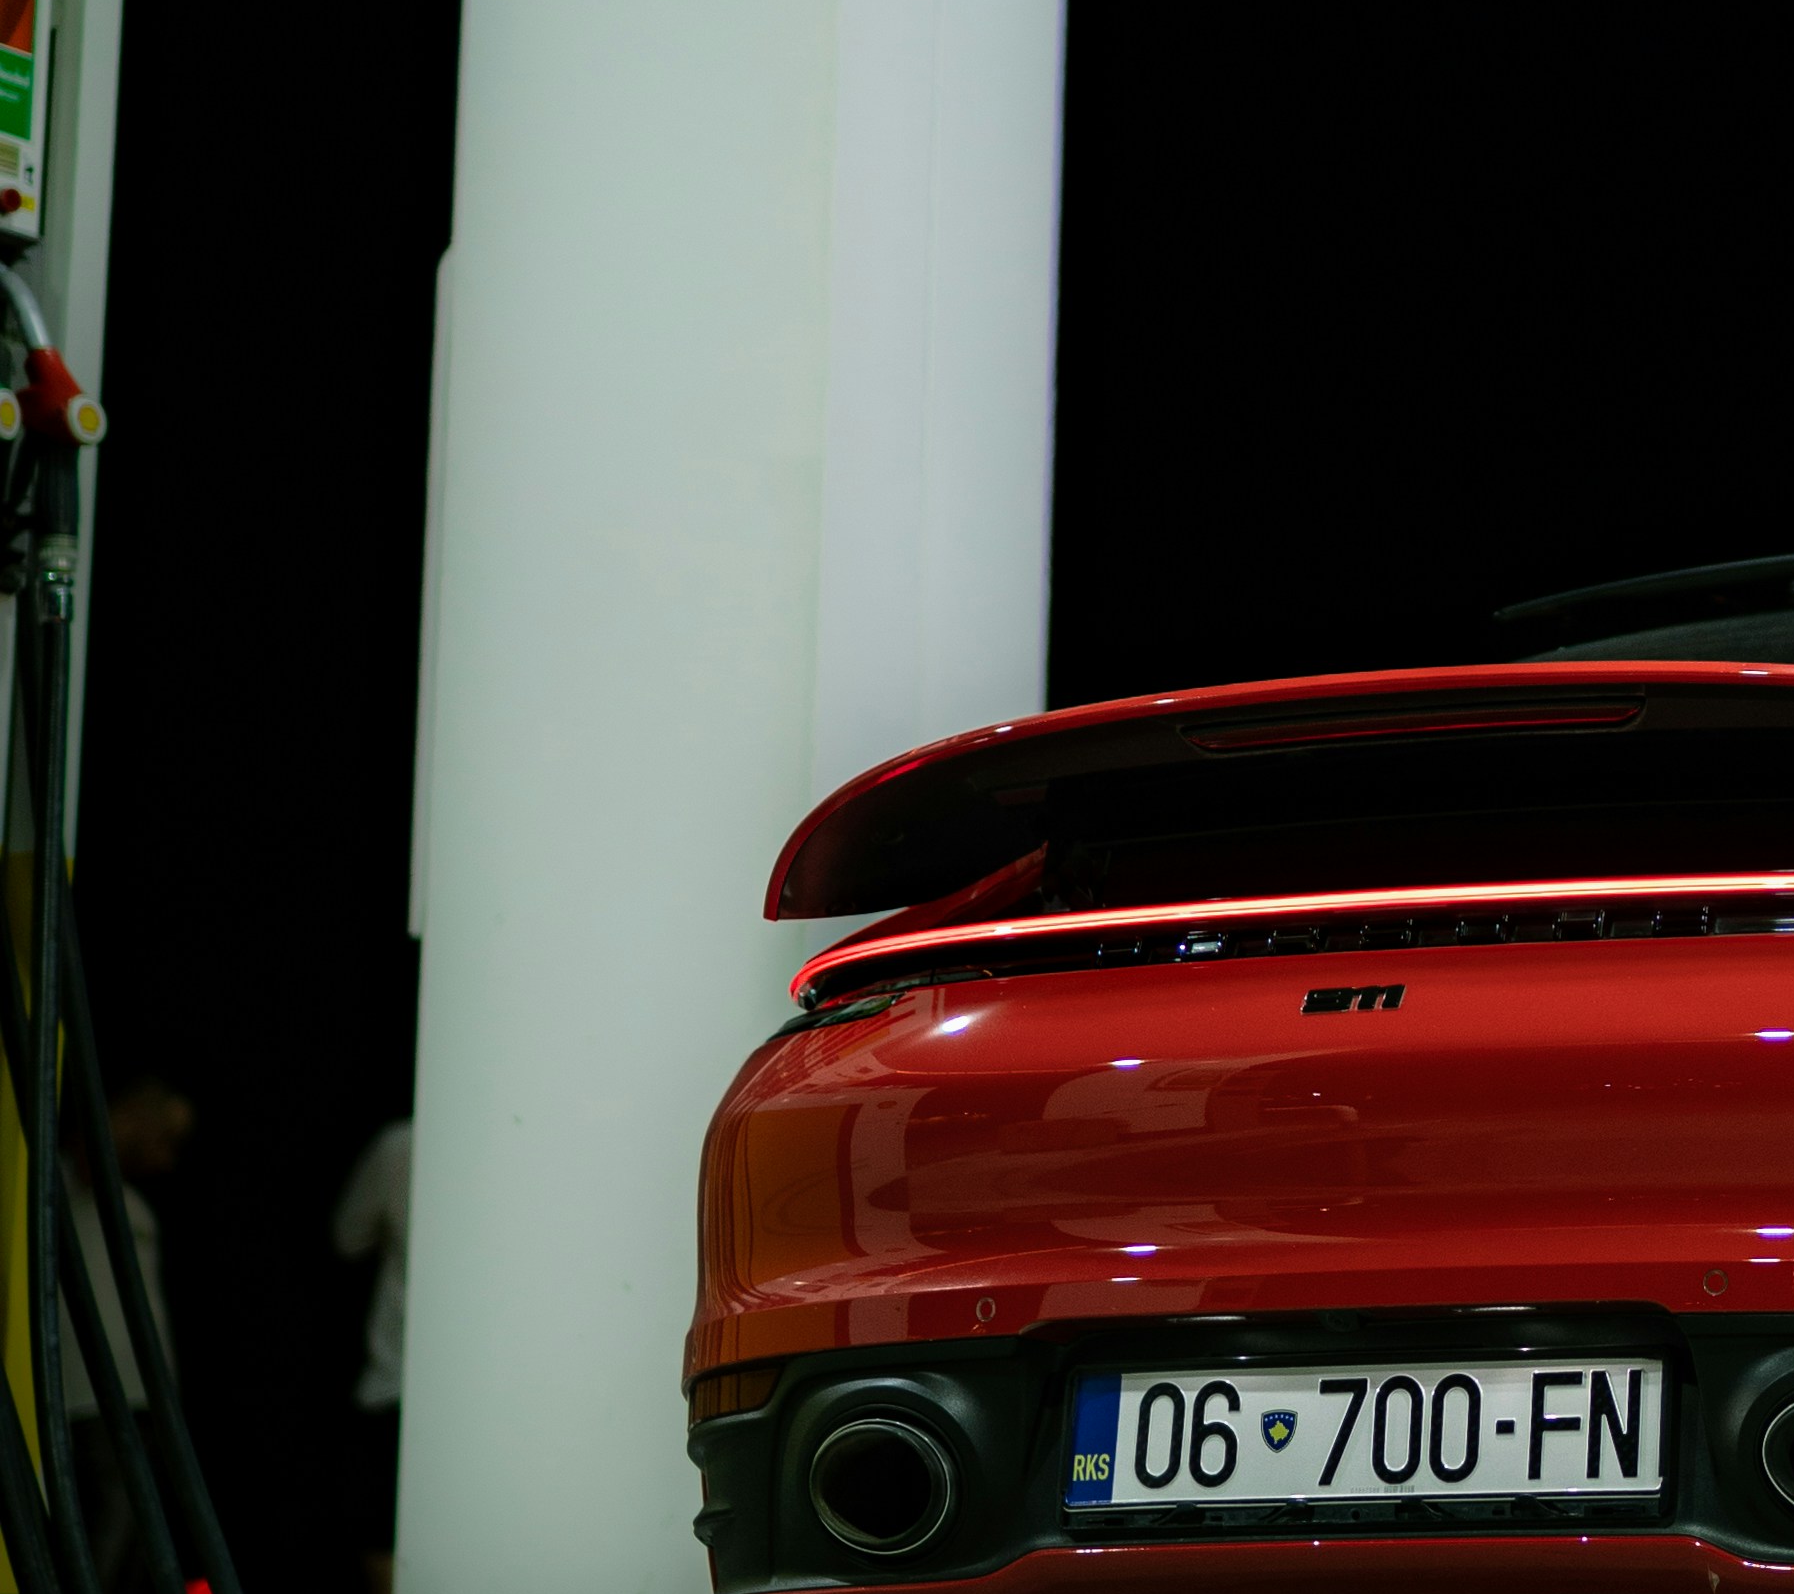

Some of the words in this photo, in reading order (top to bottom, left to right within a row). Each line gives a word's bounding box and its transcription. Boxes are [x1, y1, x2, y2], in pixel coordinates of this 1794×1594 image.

[1301, 983, 1406, 1015] 911
[1135, 1381, 1241, 1488] 06
[1318, 1368, 1643, 1486] 700-FN
[1072, 1453, 1110, 1482] RKS
